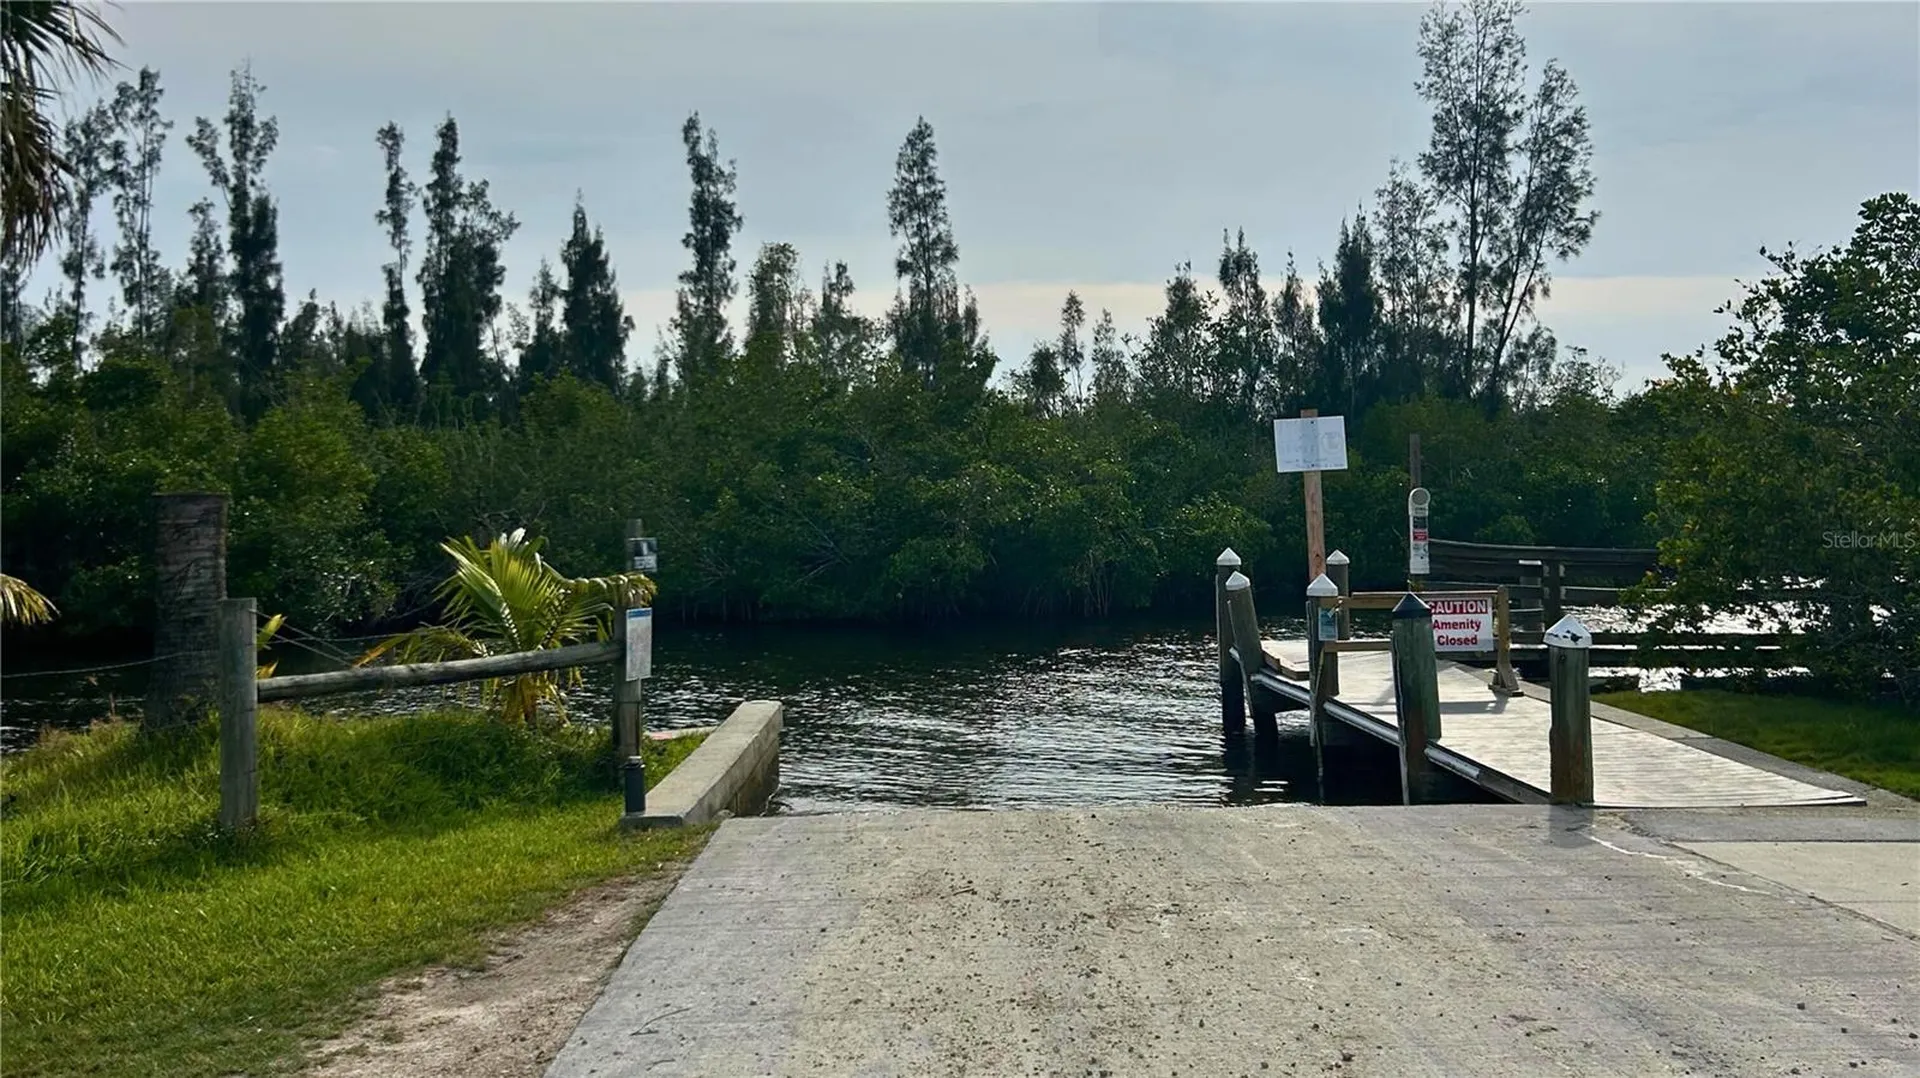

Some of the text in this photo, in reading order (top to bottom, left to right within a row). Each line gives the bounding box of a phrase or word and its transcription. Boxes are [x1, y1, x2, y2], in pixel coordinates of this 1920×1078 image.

[1428, 601, 1486, 613] CAUTION
[1433, 619, 1480, 631] Amenity
[1437, 635, 1477, 645] Closed
